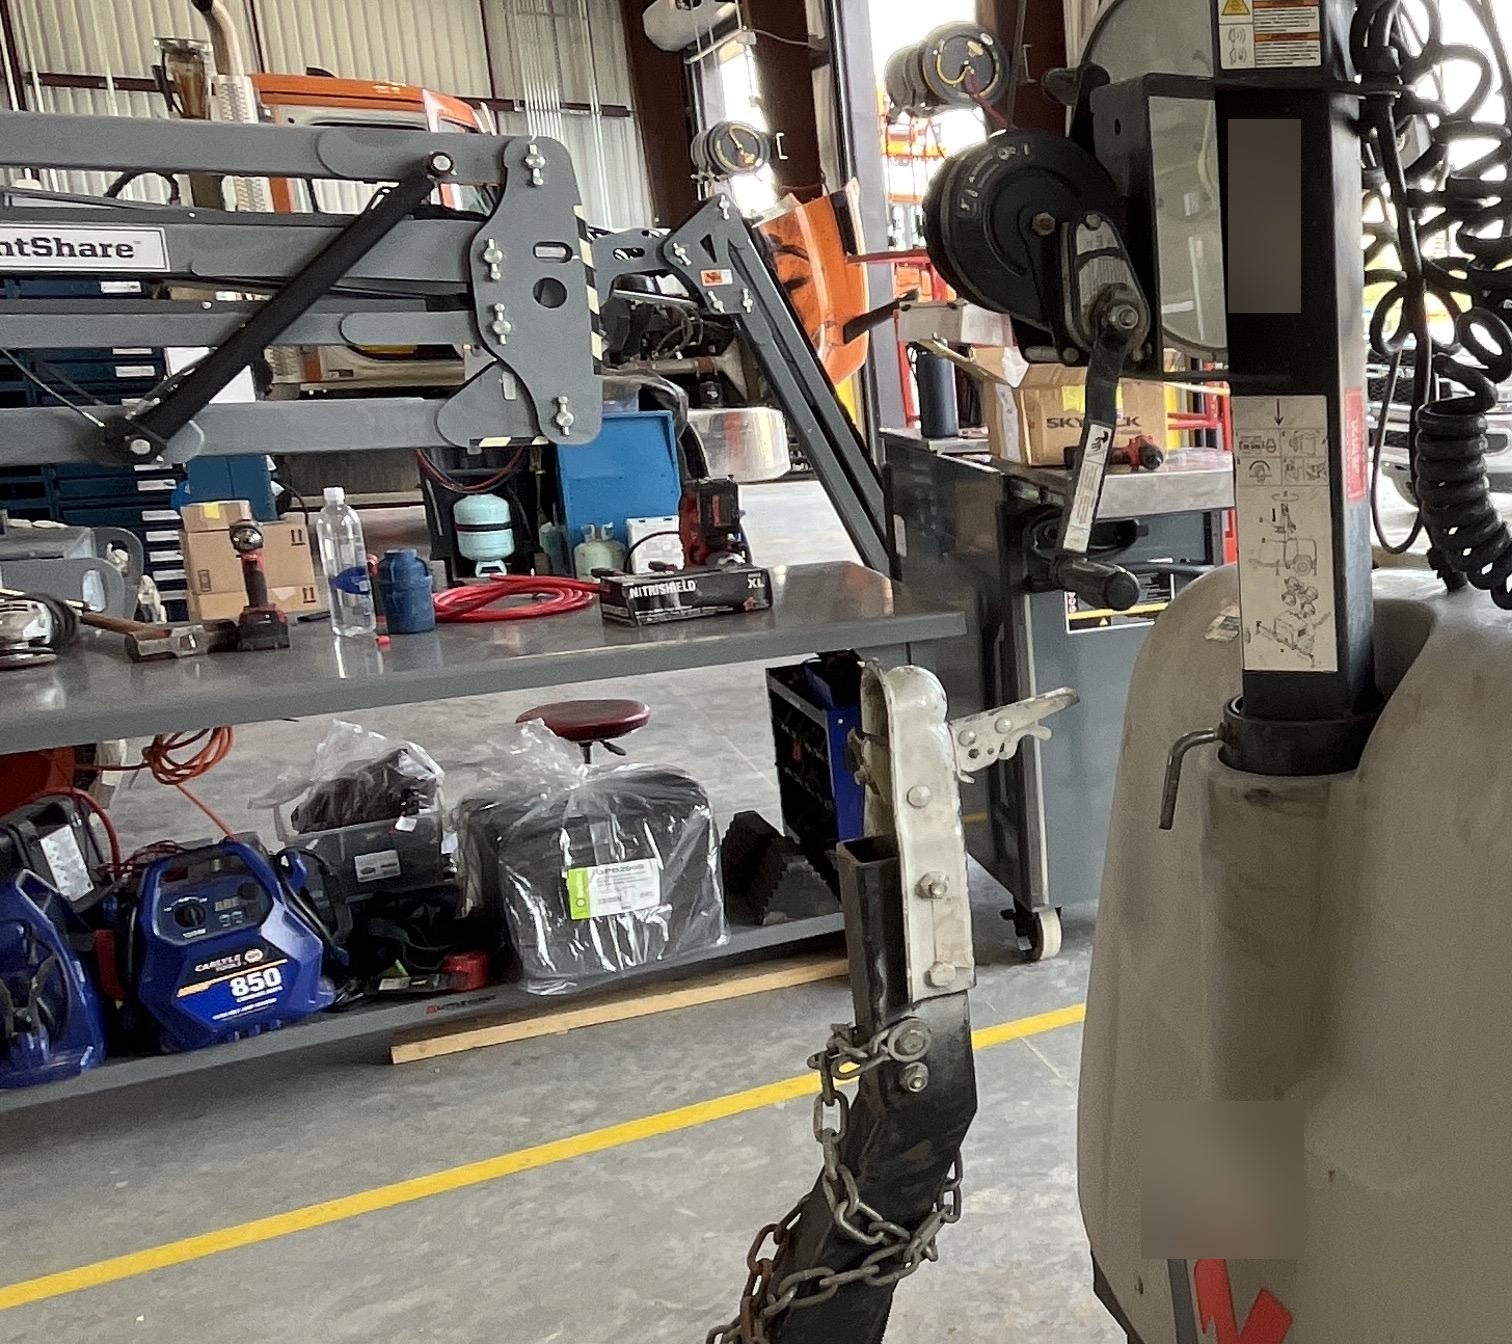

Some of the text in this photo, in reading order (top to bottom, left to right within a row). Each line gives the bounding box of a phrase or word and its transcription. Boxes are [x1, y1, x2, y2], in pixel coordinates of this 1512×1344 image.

[629, 579, 697, 600] NITRISHIELD
[747, 578, 765, 589] XL
[229, 967, 283, 997] 850
